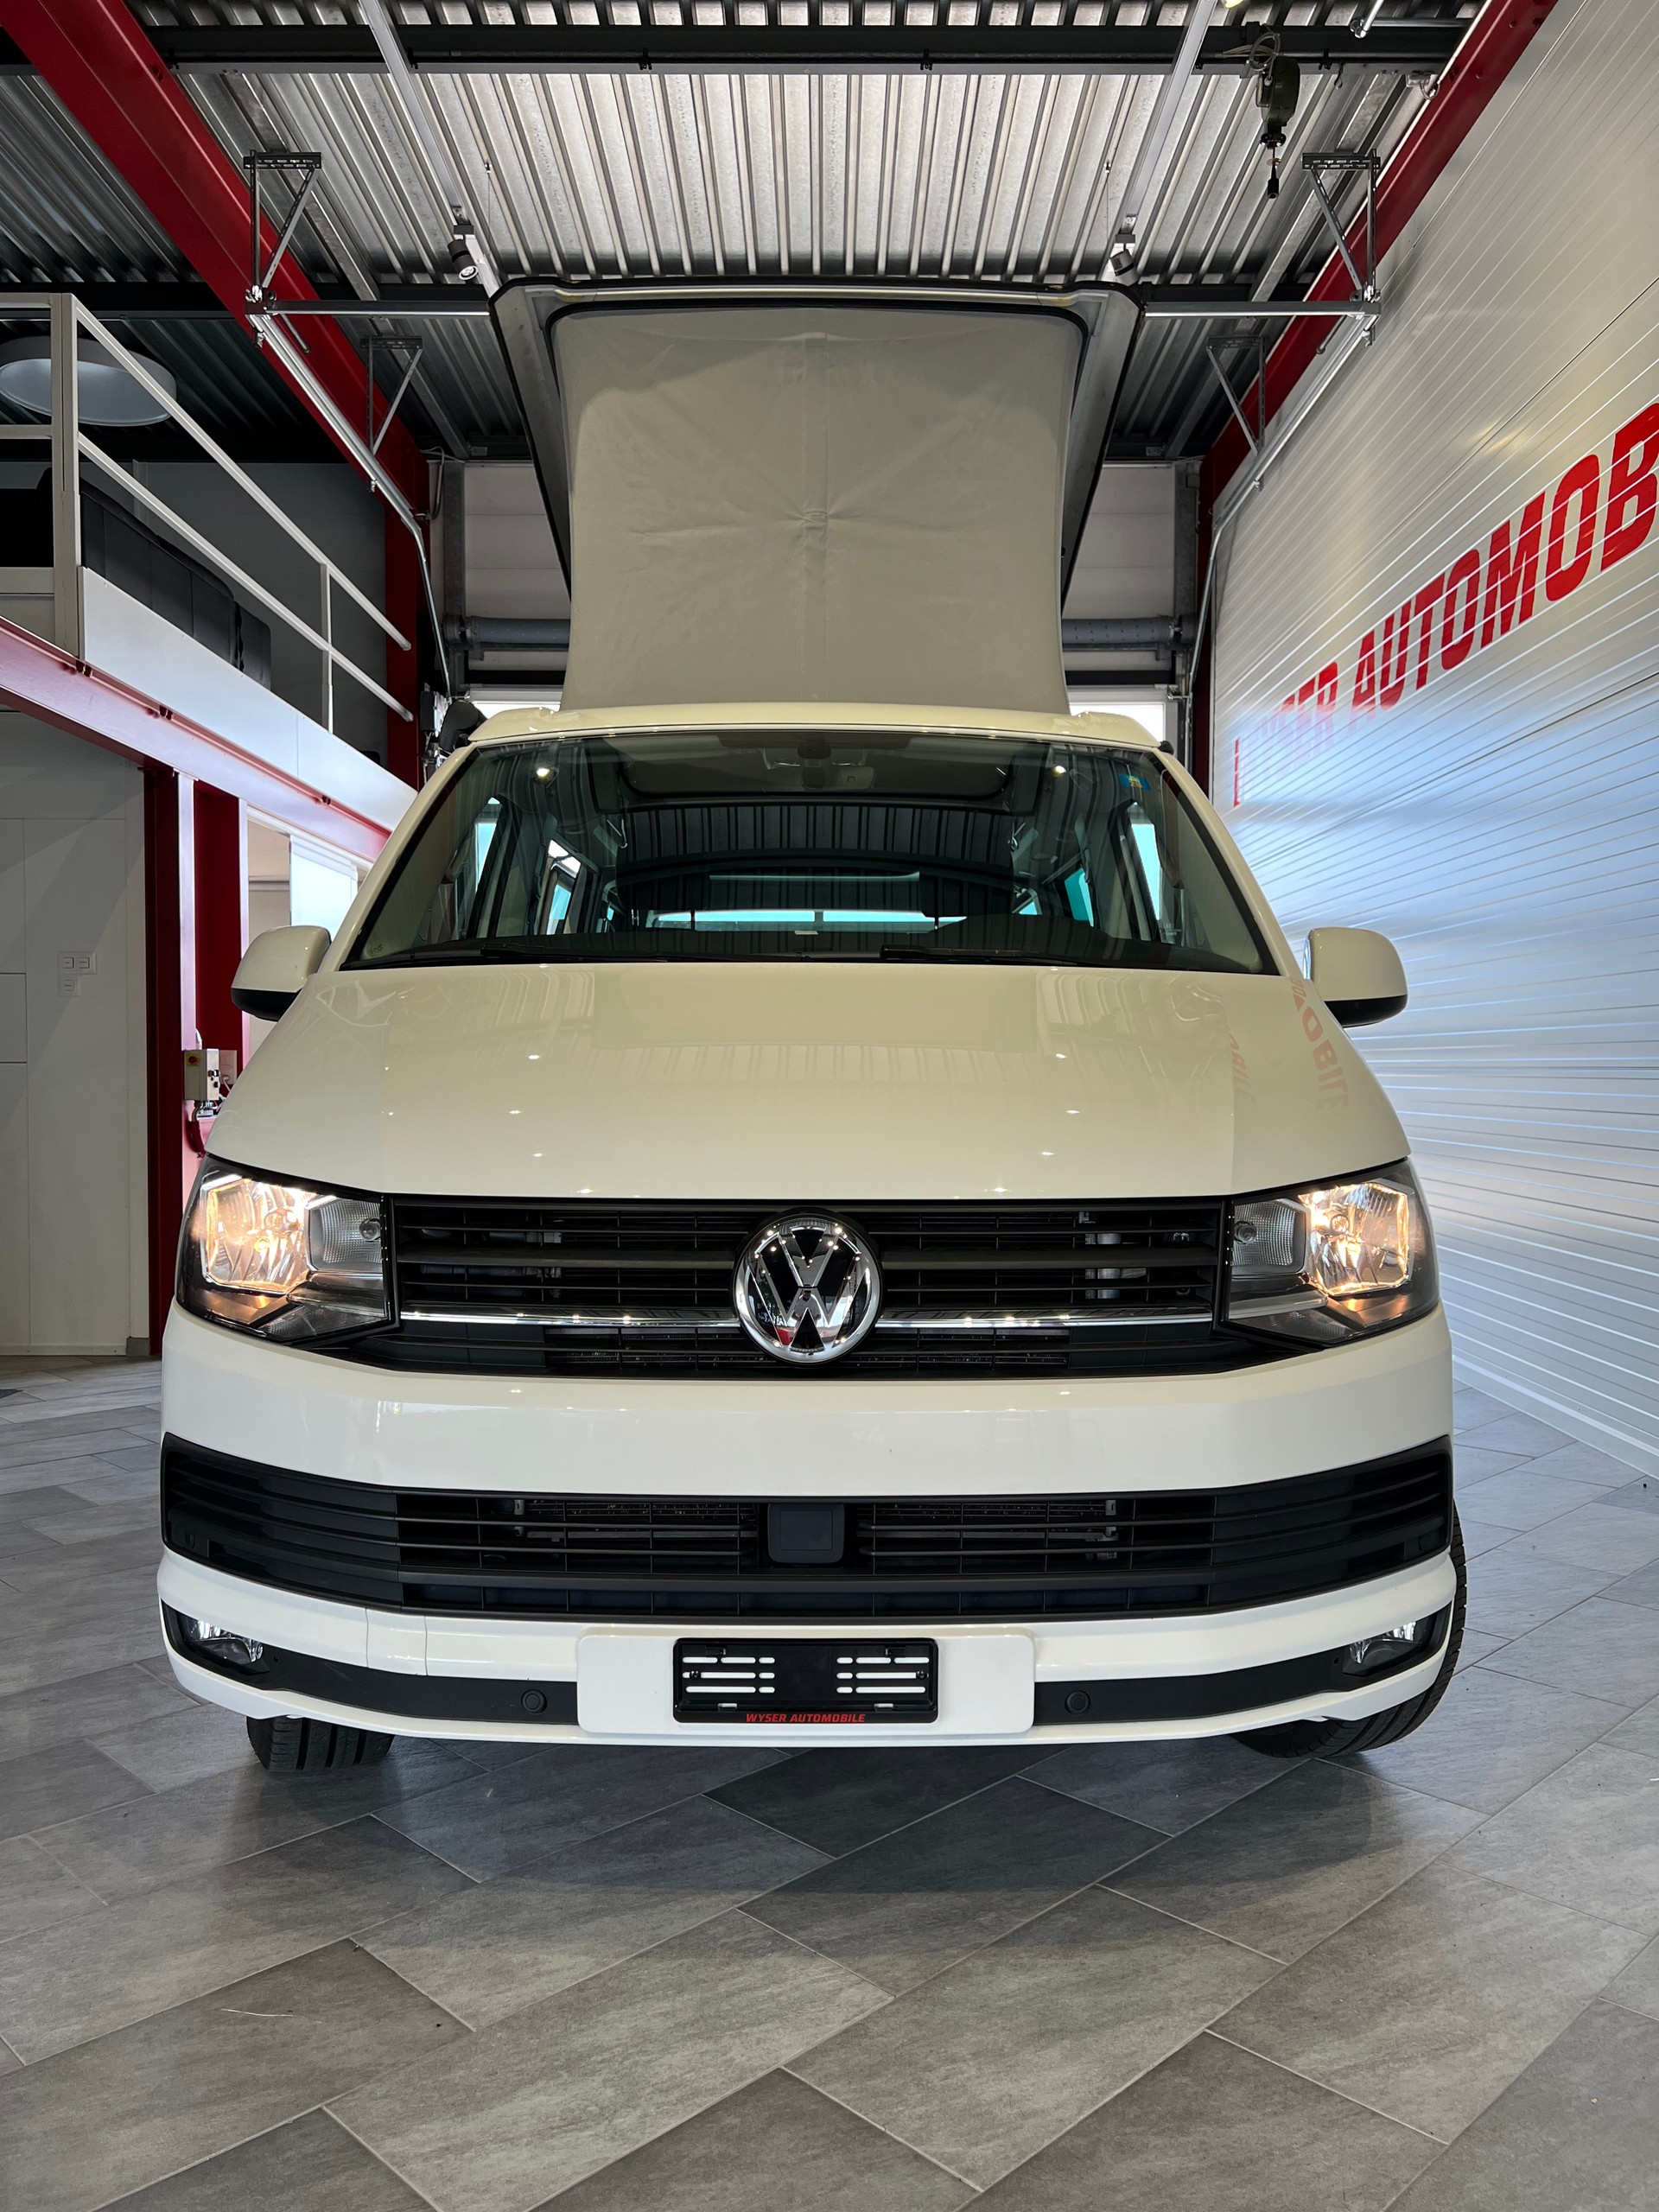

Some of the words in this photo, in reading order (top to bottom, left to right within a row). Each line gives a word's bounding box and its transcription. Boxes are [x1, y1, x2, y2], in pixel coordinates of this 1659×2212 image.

[741, 1220, 877, 1357] VW
[746, 1713, 787, 1723] WYSER
[790, 1713, 866, 1723] AUTOMOBILE
